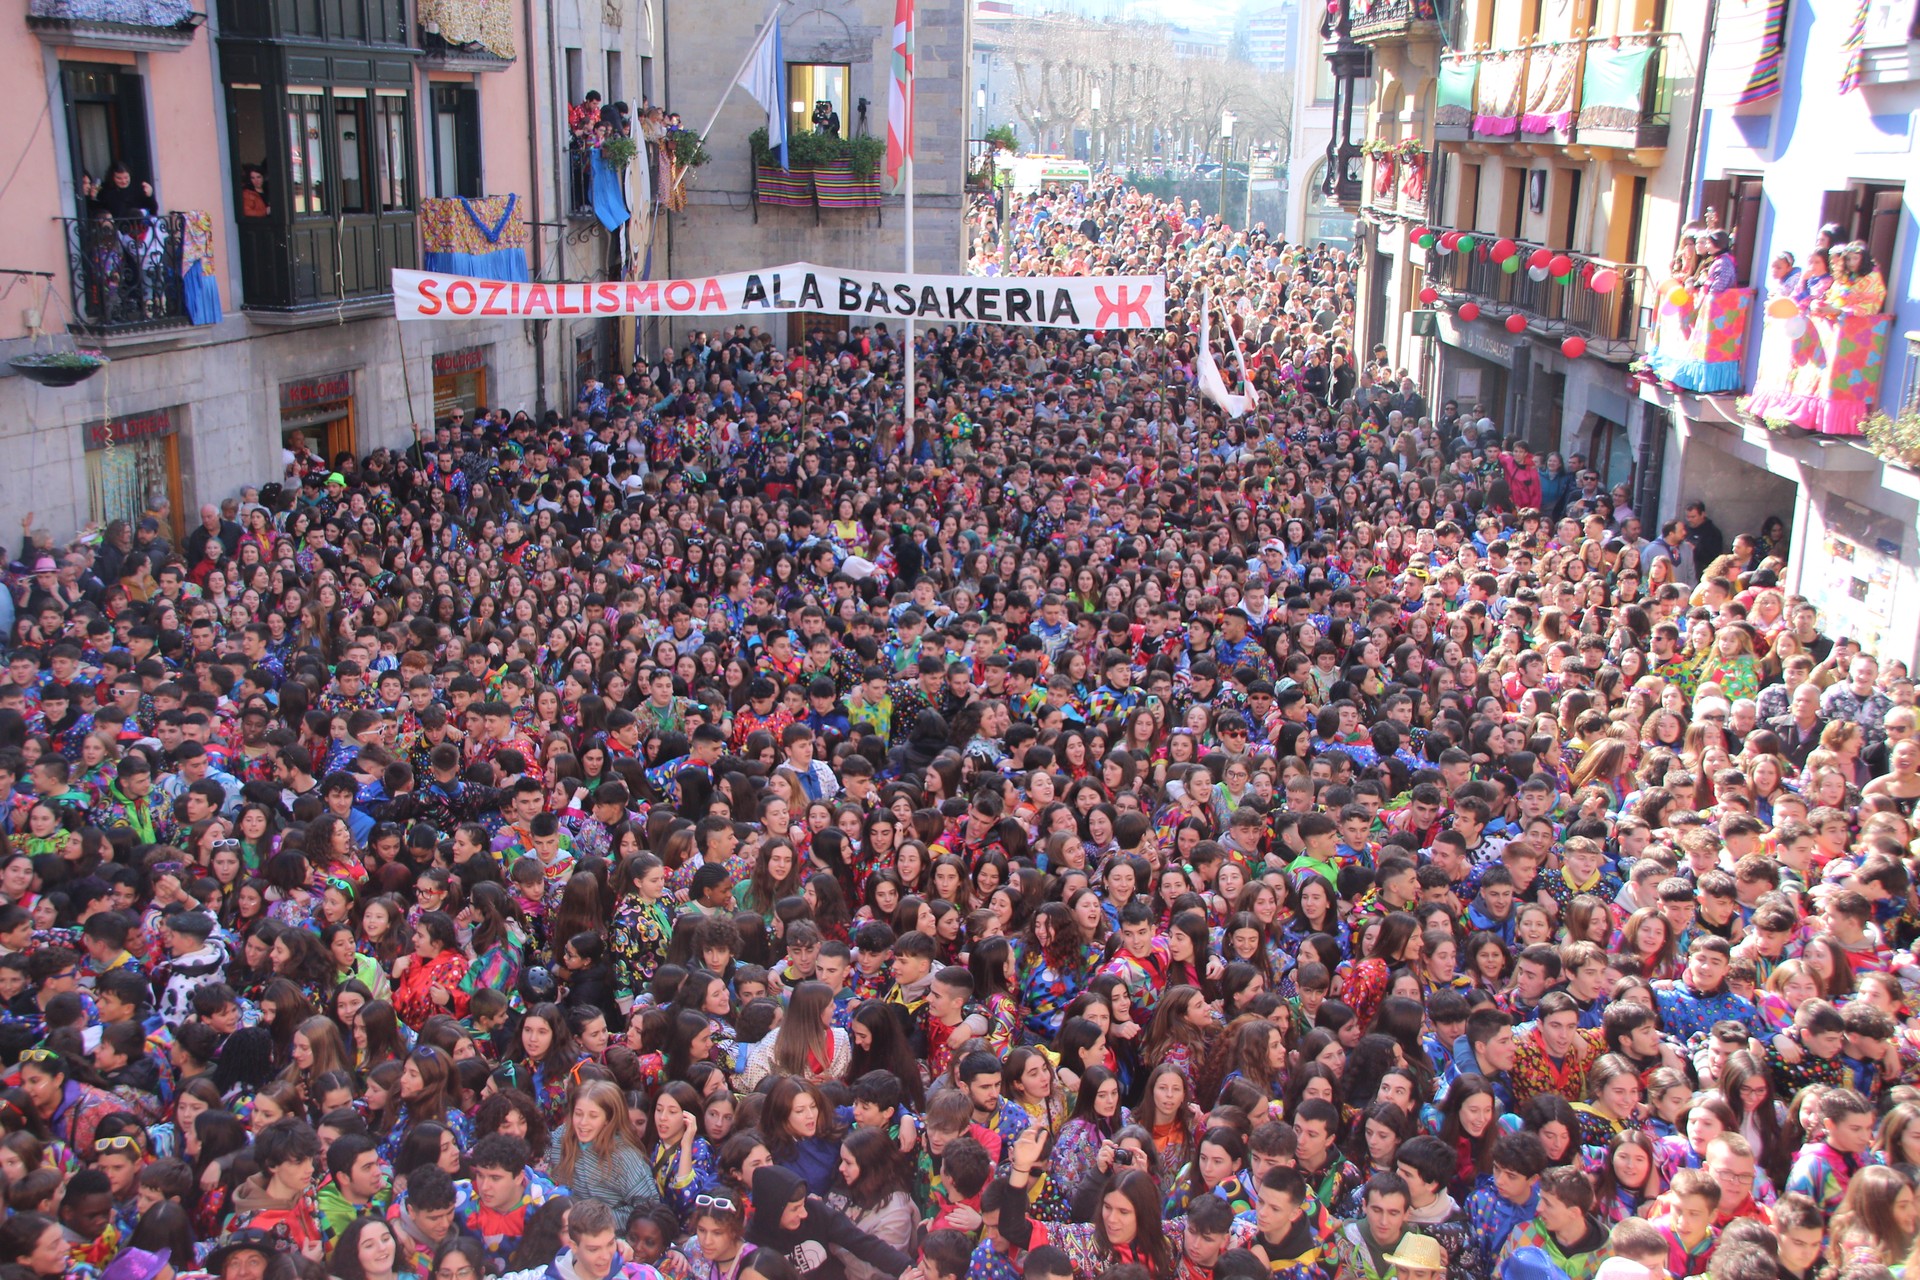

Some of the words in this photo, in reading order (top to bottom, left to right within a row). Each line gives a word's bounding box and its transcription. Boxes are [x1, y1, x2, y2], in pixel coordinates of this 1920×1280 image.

[417, 278, 727, 315] SOZIALISMOA
[741, 273, 824, 309] ALA
[838, 276, 1080, 325] BASAKERIA
